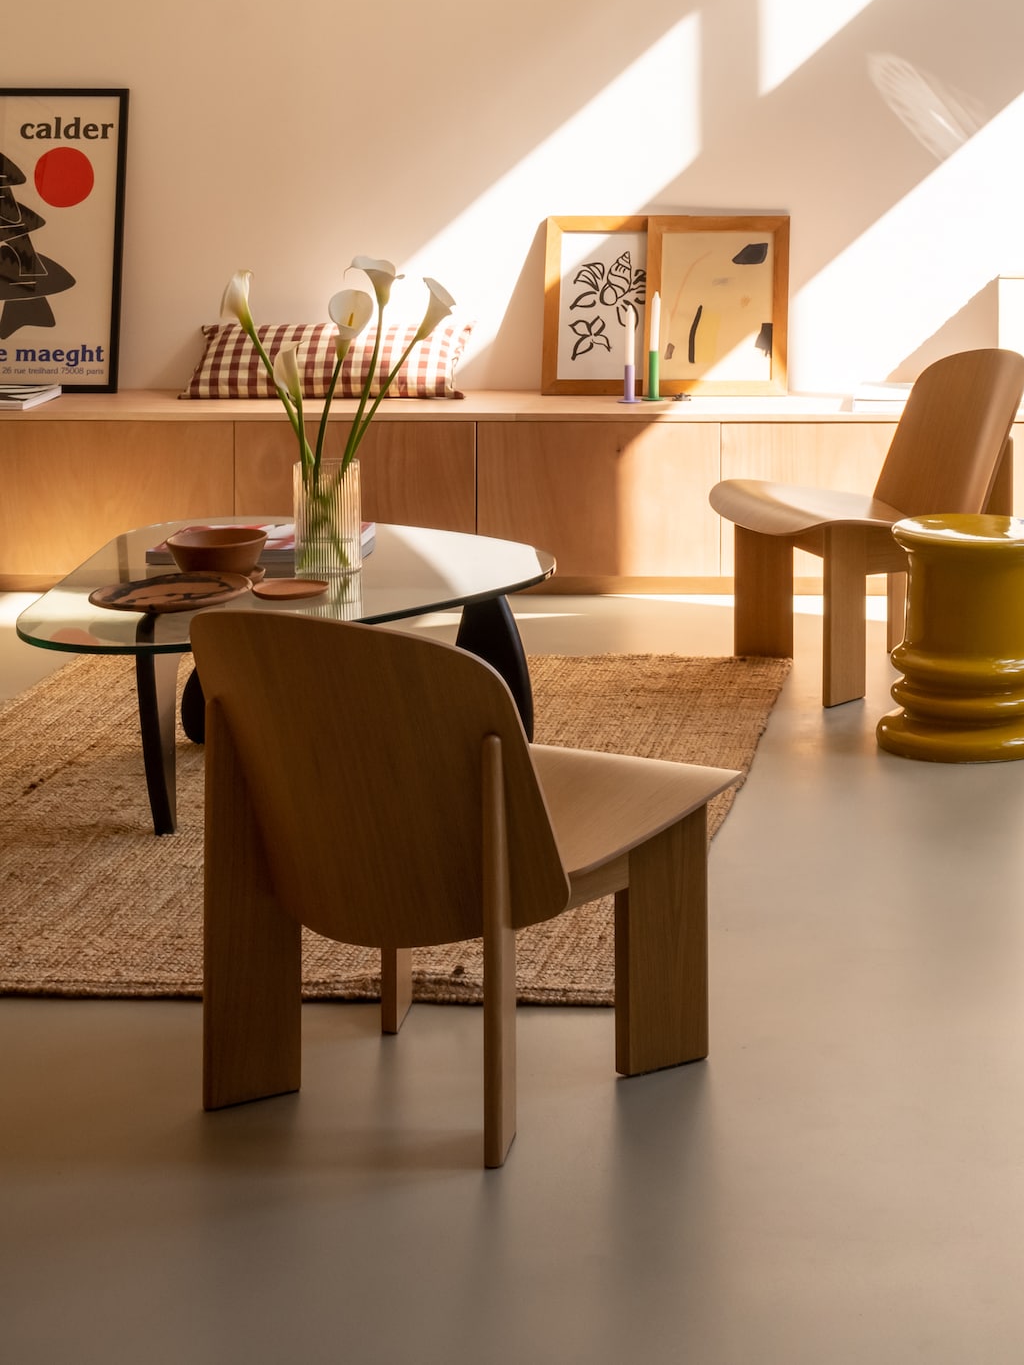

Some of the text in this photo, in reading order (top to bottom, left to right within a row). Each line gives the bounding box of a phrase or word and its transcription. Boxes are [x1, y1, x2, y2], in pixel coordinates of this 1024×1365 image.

[20, 116, 114, 140] calder
[15, 344, 104, 367] maeght
[2, 366, 12, 375] 26
[14, 367, 27, 375] rue
[86, 367, 104, 376] paris
